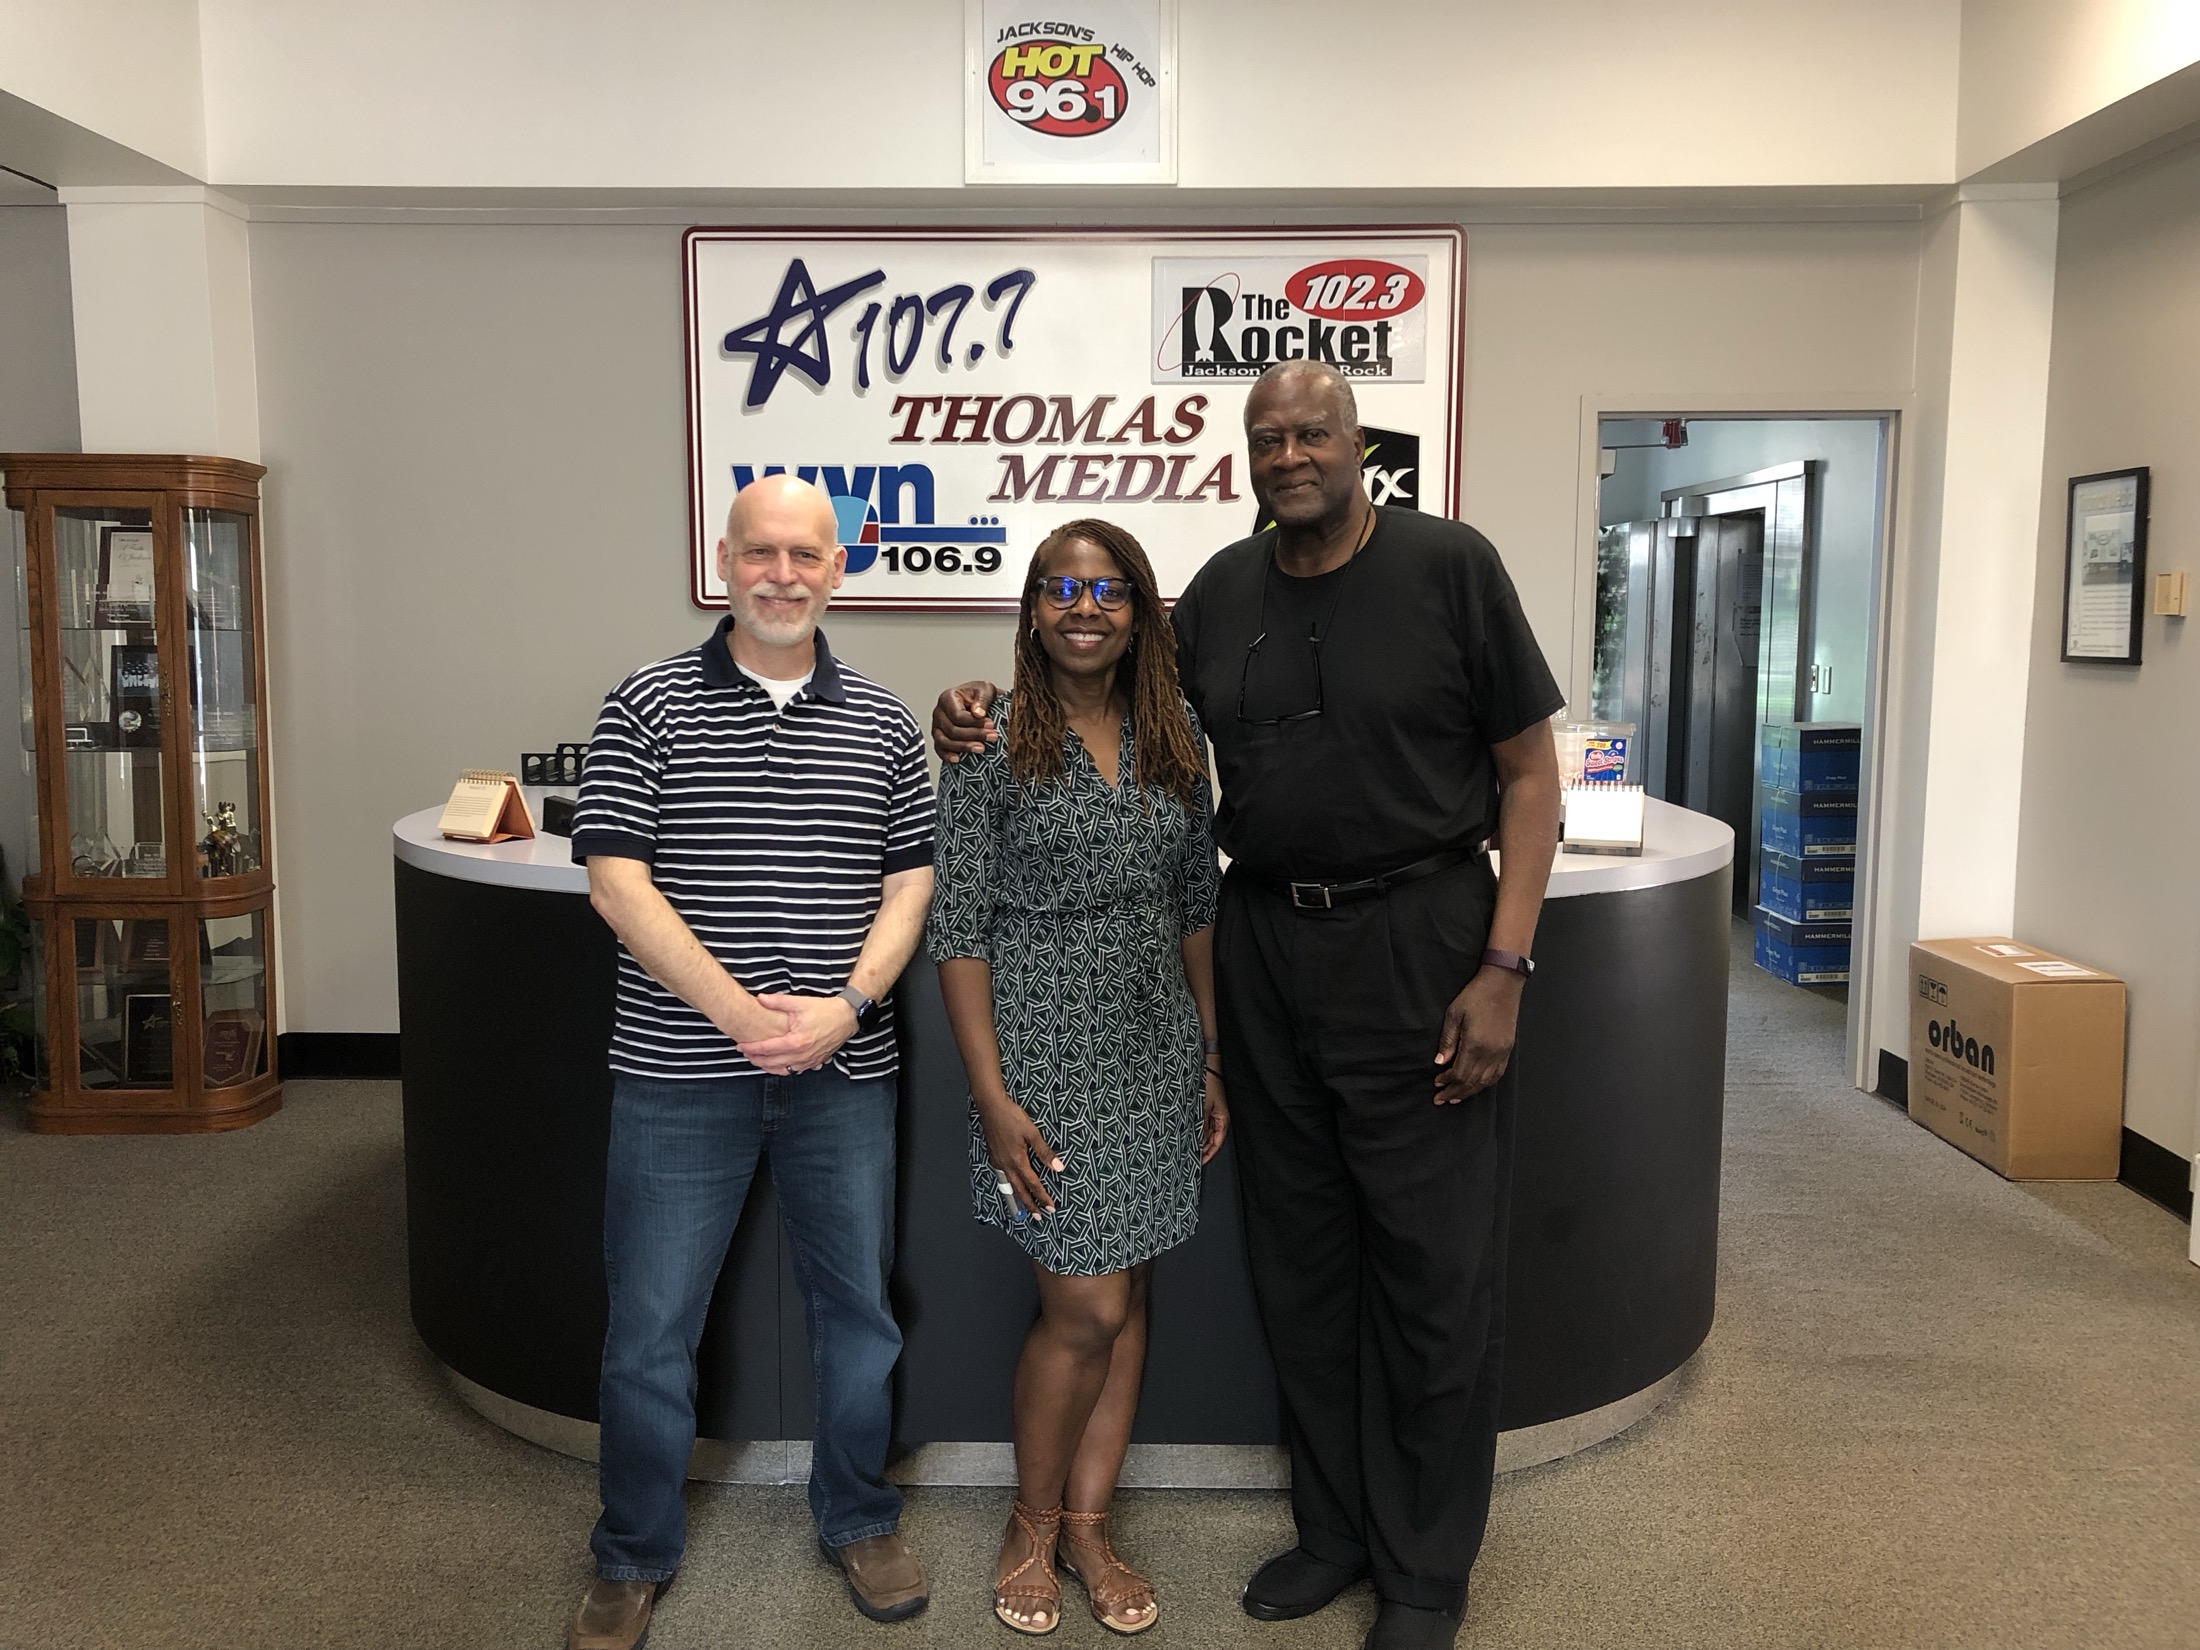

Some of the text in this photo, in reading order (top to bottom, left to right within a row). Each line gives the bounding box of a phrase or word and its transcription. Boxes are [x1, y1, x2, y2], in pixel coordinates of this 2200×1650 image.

[997, 21, 1095, 43] JACKSON'S
[1001, 44, 1105, 78] HOT
[1110, 43, 1157, 88] HIP HOP
[1005, 79, 1118, 123] 96.1
[1242, 294, 1290, 321] The
[1302, 274, 1411, 311] 102.3
[854, 269, 1037, 392] 107.7
[1182, 286, 1393, 363] Rocket
[1184, 364, 1388, 377] Jackson' Rock
[888, 394, 1209, 444] THOMAS
[986, 452, 1242, 503] MEDIA
[881, 546, 1001, 573] 106.9
[1927, 1019, 1995, 1076] orban
